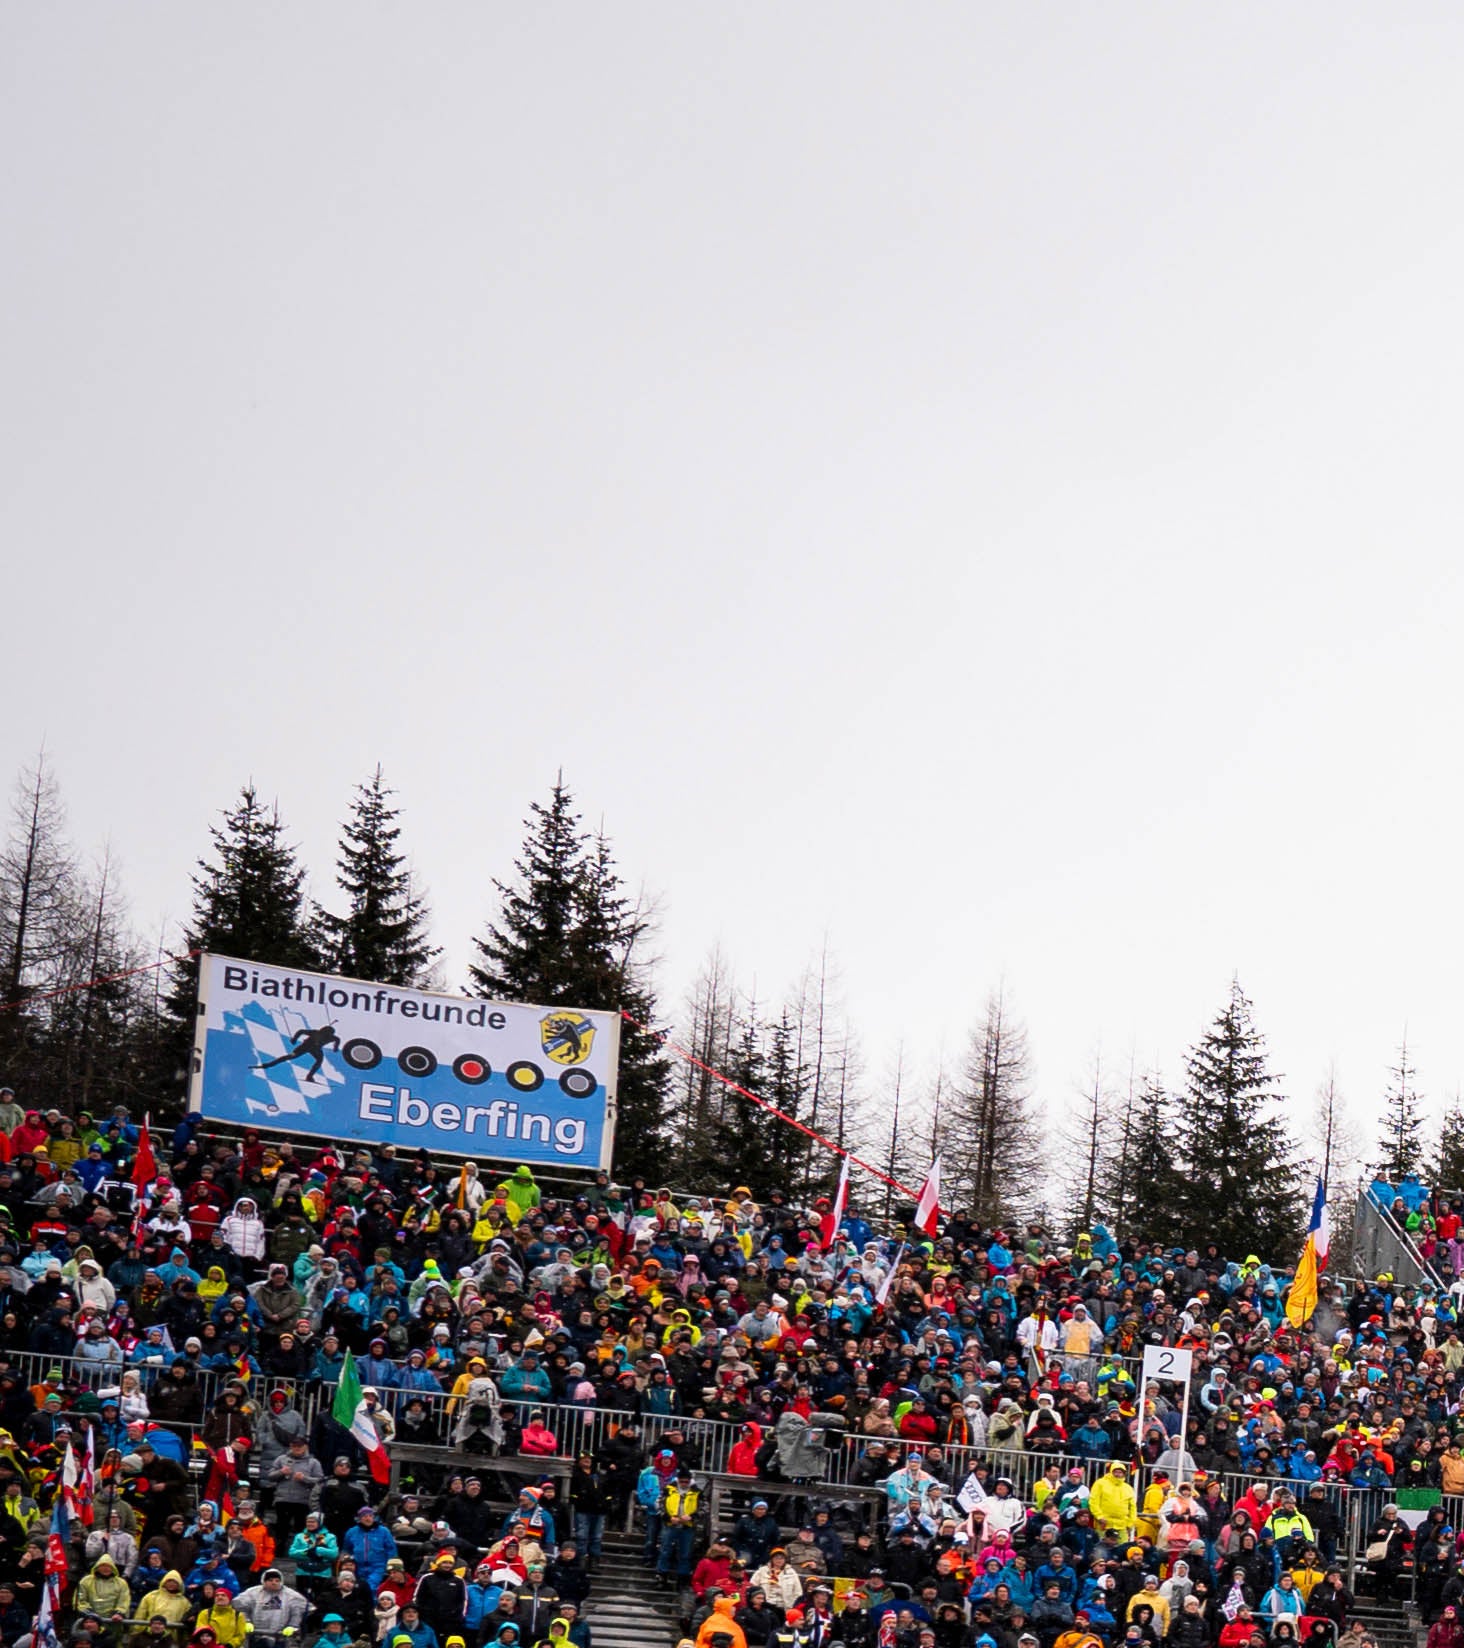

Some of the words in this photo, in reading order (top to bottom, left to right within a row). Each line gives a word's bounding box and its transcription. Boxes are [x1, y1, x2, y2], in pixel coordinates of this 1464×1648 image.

[222, 964, 508, 1031] Biathlonfreunde
[358, 1081, 588, 1155] Eberfing
[1158, 1351, 1174, 1375] 2
